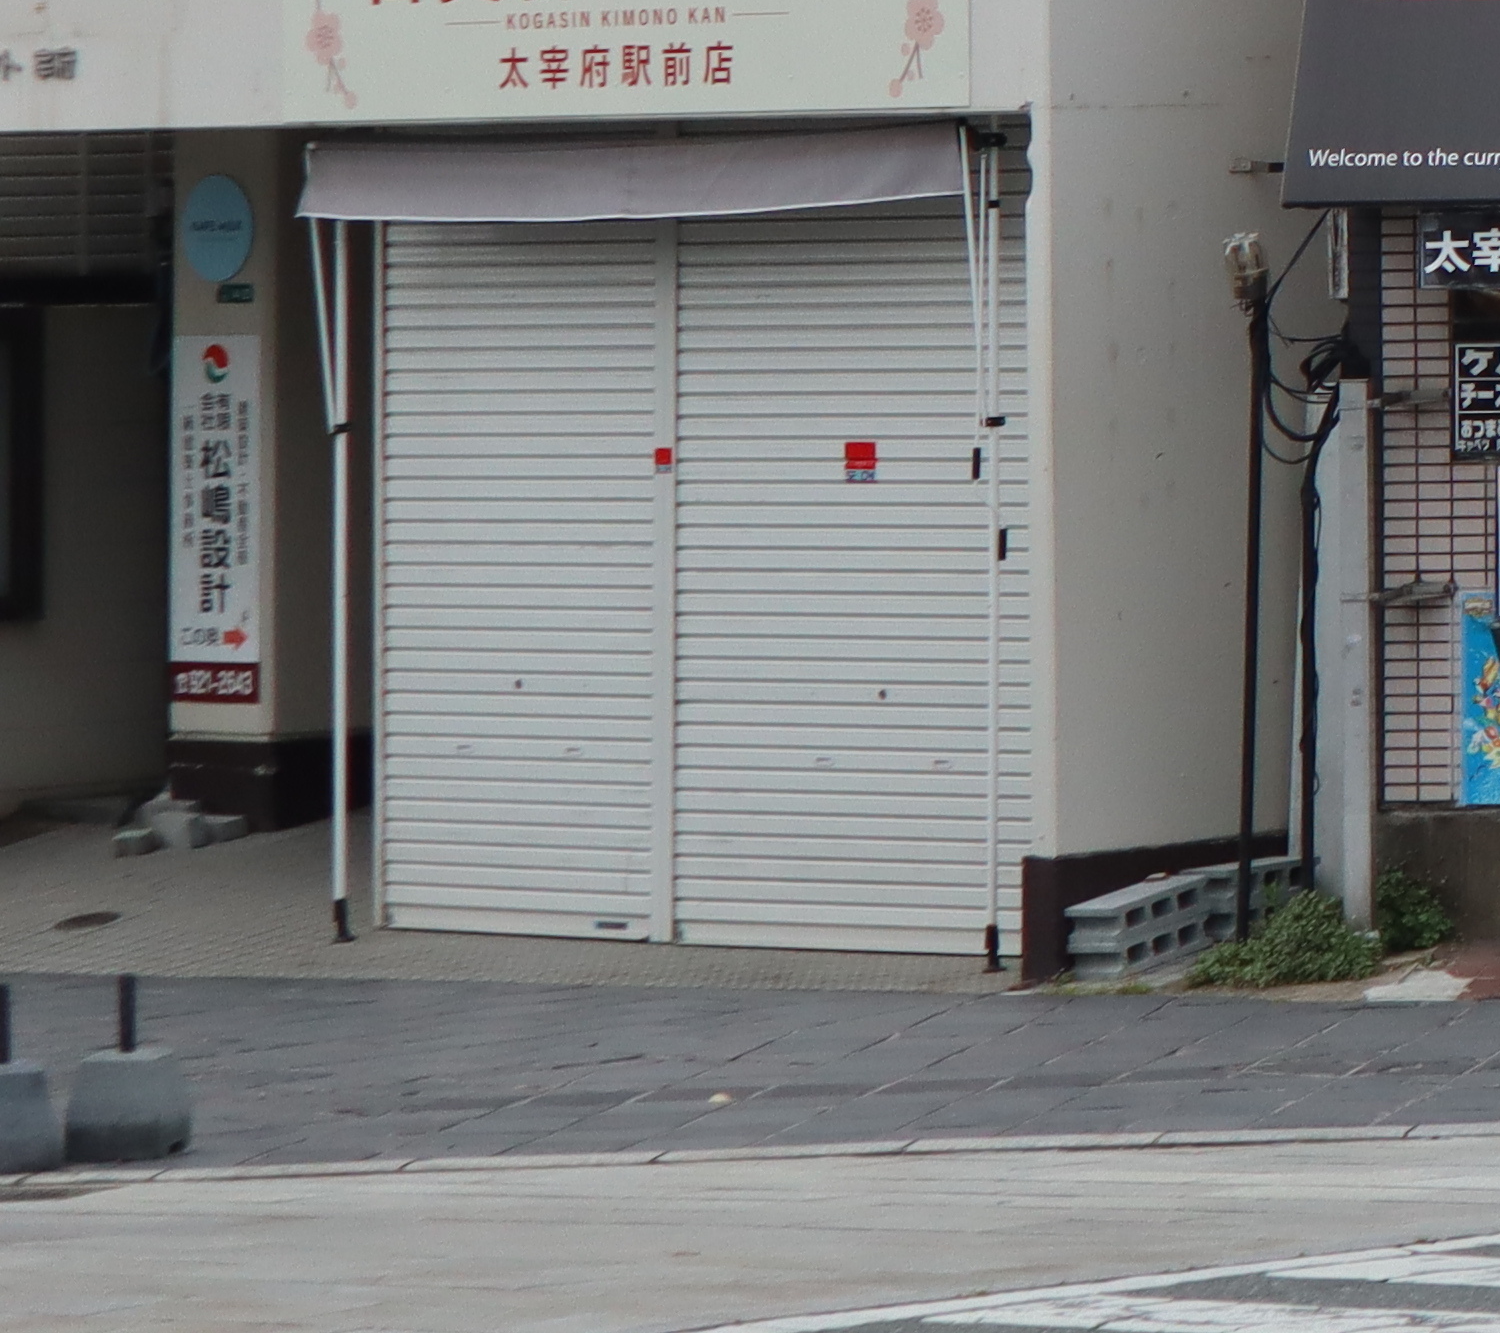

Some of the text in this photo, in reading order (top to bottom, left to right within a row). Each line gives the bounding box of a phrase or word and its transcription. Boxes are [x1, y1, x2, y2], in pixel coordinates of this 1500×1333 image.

[505, 7, 727, 31] KOGASIN KIMONO KAN
[499, 41, 735, 90] 太宰府駅前店
[1308, 147, 1398, 167] Welcome
[1402, 149, 1424, 167] to
[1427, 146, 1460, 166] the
